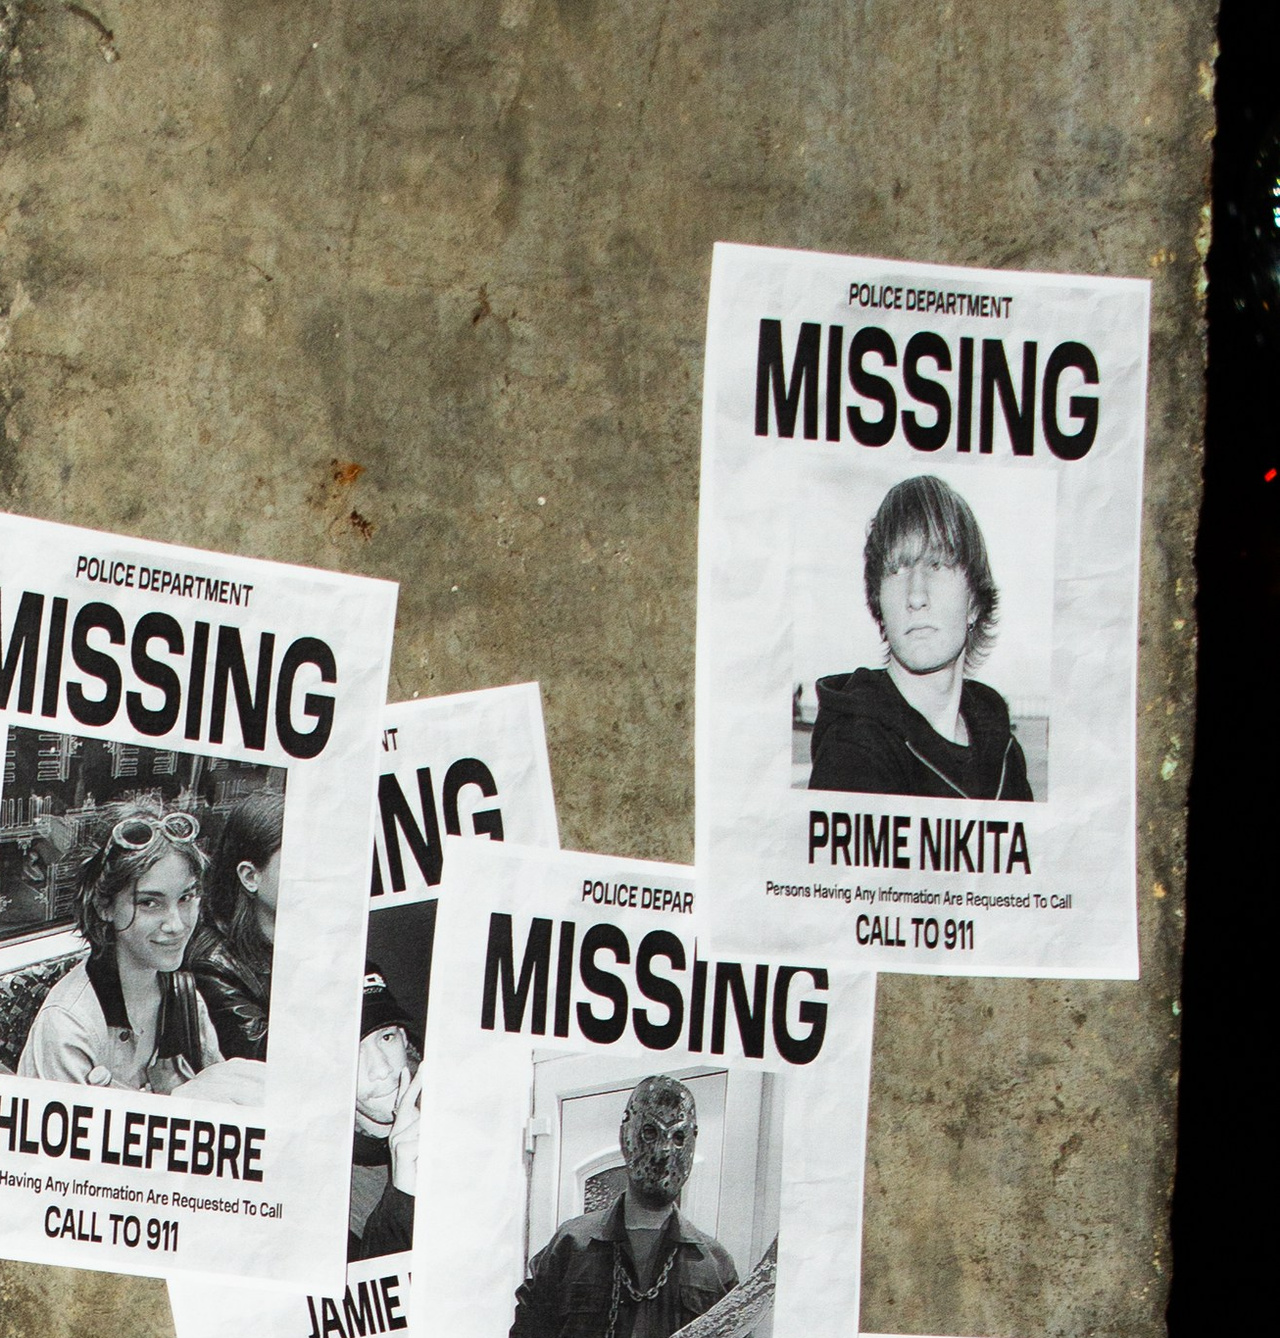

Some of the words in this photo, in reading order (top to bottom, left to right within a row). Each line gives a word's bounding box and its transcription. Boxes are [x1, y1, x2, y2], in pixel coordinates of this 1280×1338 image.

[848, 283, 903, 310] POLICE
[905, 288, 1013, 319] DEPARTMENT
[754, 318, 1100, 460] MISSING
[75, 555, 136, 588] POLICE
[138, 566, 254, 607] DEPARTMENT
[808, 810, 912, 870] PRIME
[919, 817, 1032, 875] NIKITA
[581, 879, 639, 908] POLICE
[766, 880, 811, 898] Persons
[813, 883, 852, 903] Having
[854, 885, 876, 904] Any
[878, 886, 941, 905] Information
[943, 890, 964, 906] Are
[966, 891, 1031, 909] Requested
[1032, 893, 1048, 909] To
[1050, 894, 1072, 909] Call
[855, 913, 907, 947] CALL
[911, 917, 940, 950] TO
[944, 918, 974, 950] 911
[481, 912, 829, 1065] MISSING
[100, 1108, 266, 1183] LEFEBRE
[44, 1176, 70, 1197] Any
[72, 1179, 144, 1203] Information
[146, 1188, 169, 1206] Are
[171, 1191, 240, 1214] Requested
[242, 1199, 257, 1216] To
[259, 1202, 283, 1219] Call
[44, 1205, 103, 1243] CALL
[108, 1213, 141, 1248] TO
[146, 1217, 179, 1252] 911
